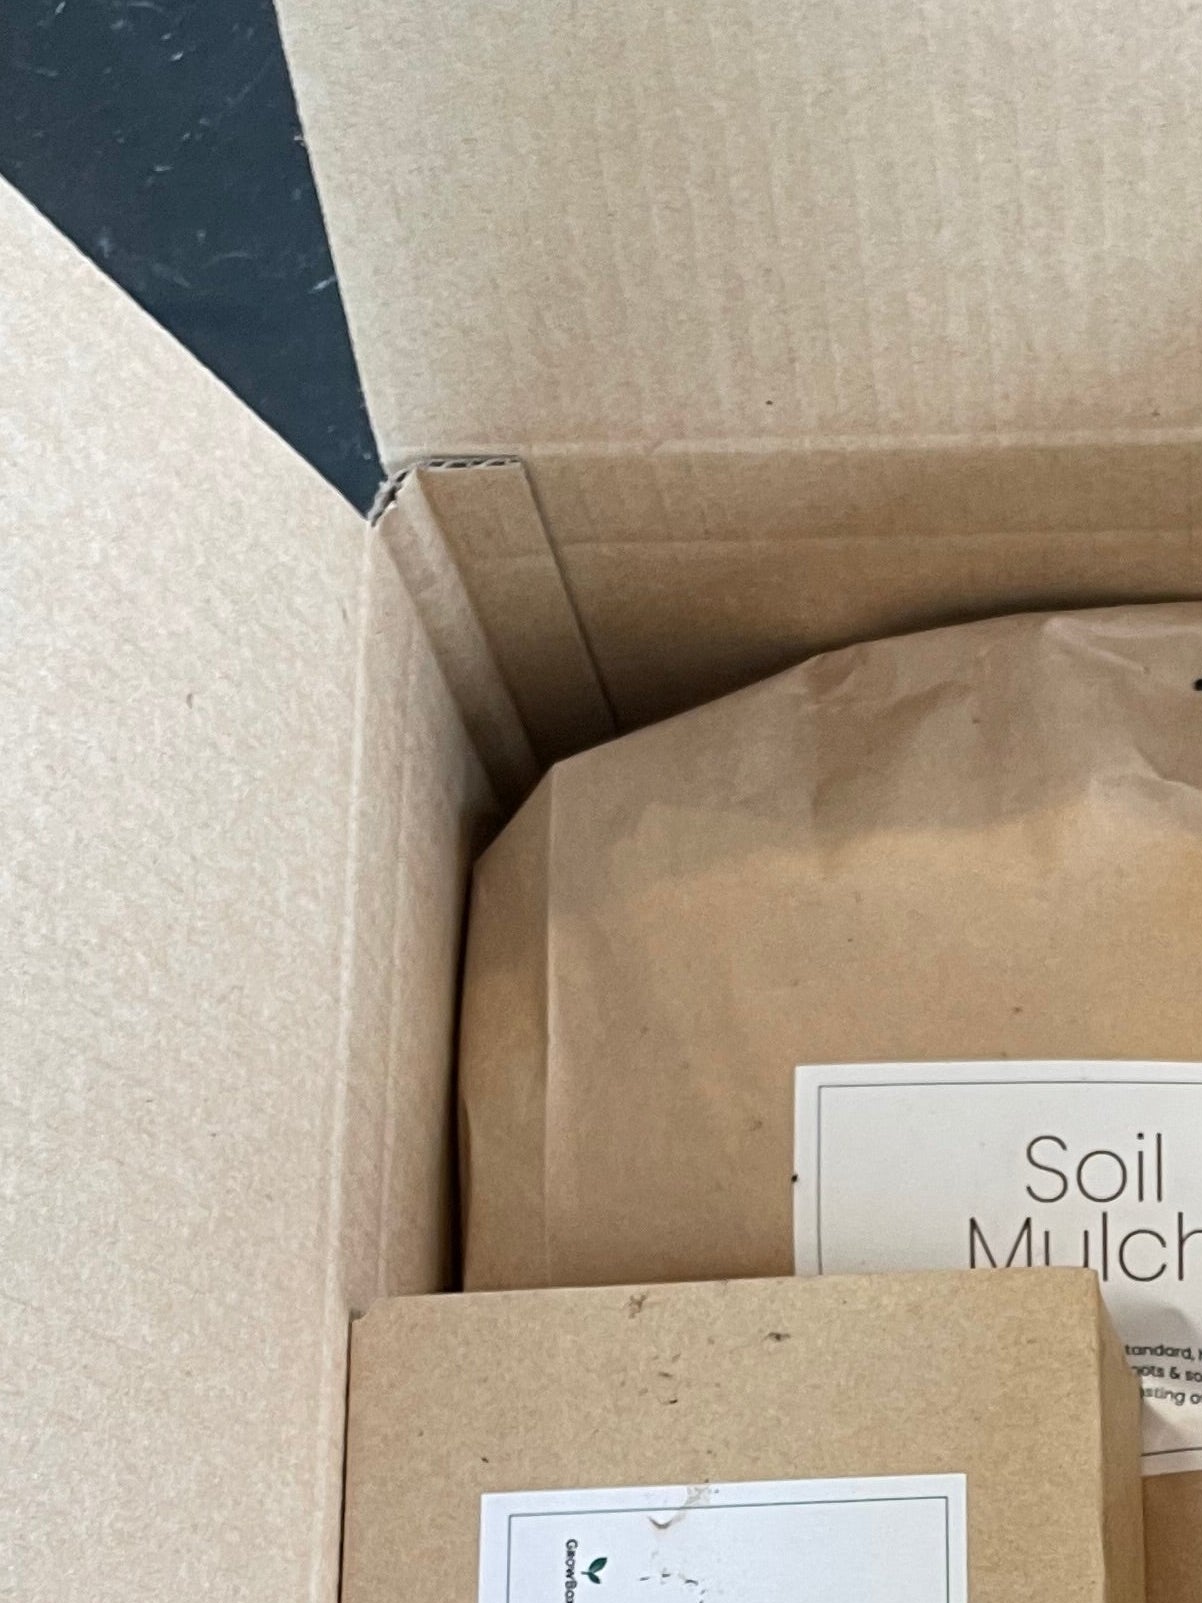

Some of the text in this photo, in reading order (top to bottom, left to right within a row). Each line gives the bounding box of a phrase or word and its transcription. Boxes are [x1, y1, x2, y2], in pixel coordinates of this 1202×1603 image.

[1025, 1131, 1164, 1204] Soil
[1124, 1344, 1195, 1362] tandard,
[1170, 1366, 1181, 1380] &
